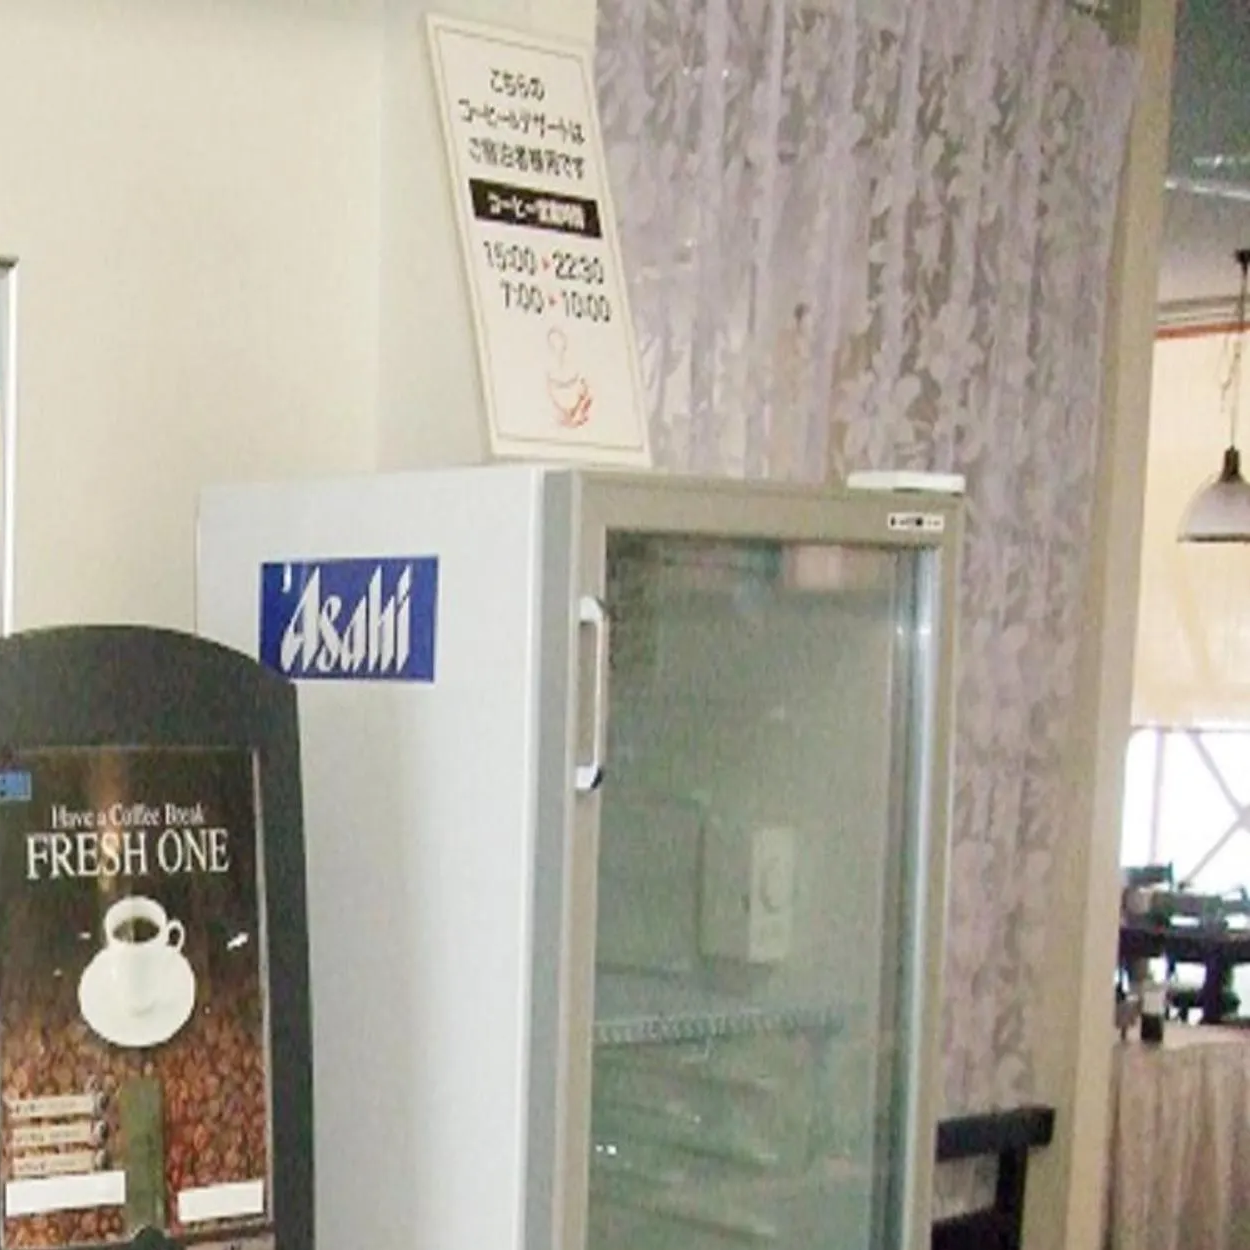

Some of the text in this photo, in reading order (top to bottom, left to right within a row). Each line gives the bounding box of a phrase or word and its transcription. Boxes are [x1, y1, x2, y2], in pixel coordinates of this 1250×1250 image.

[489, 68, 545, 101] こちらの
[483, 241, 537, 275] 15:00
[501, 280, 611, 322] 7:00 10:00
[52, 805, 93, 829] Have
[111, 803, 160, 828] Coffee
[165, 802, 205, 826] Break
[26, 829, 230, 880] FRESH ONE
